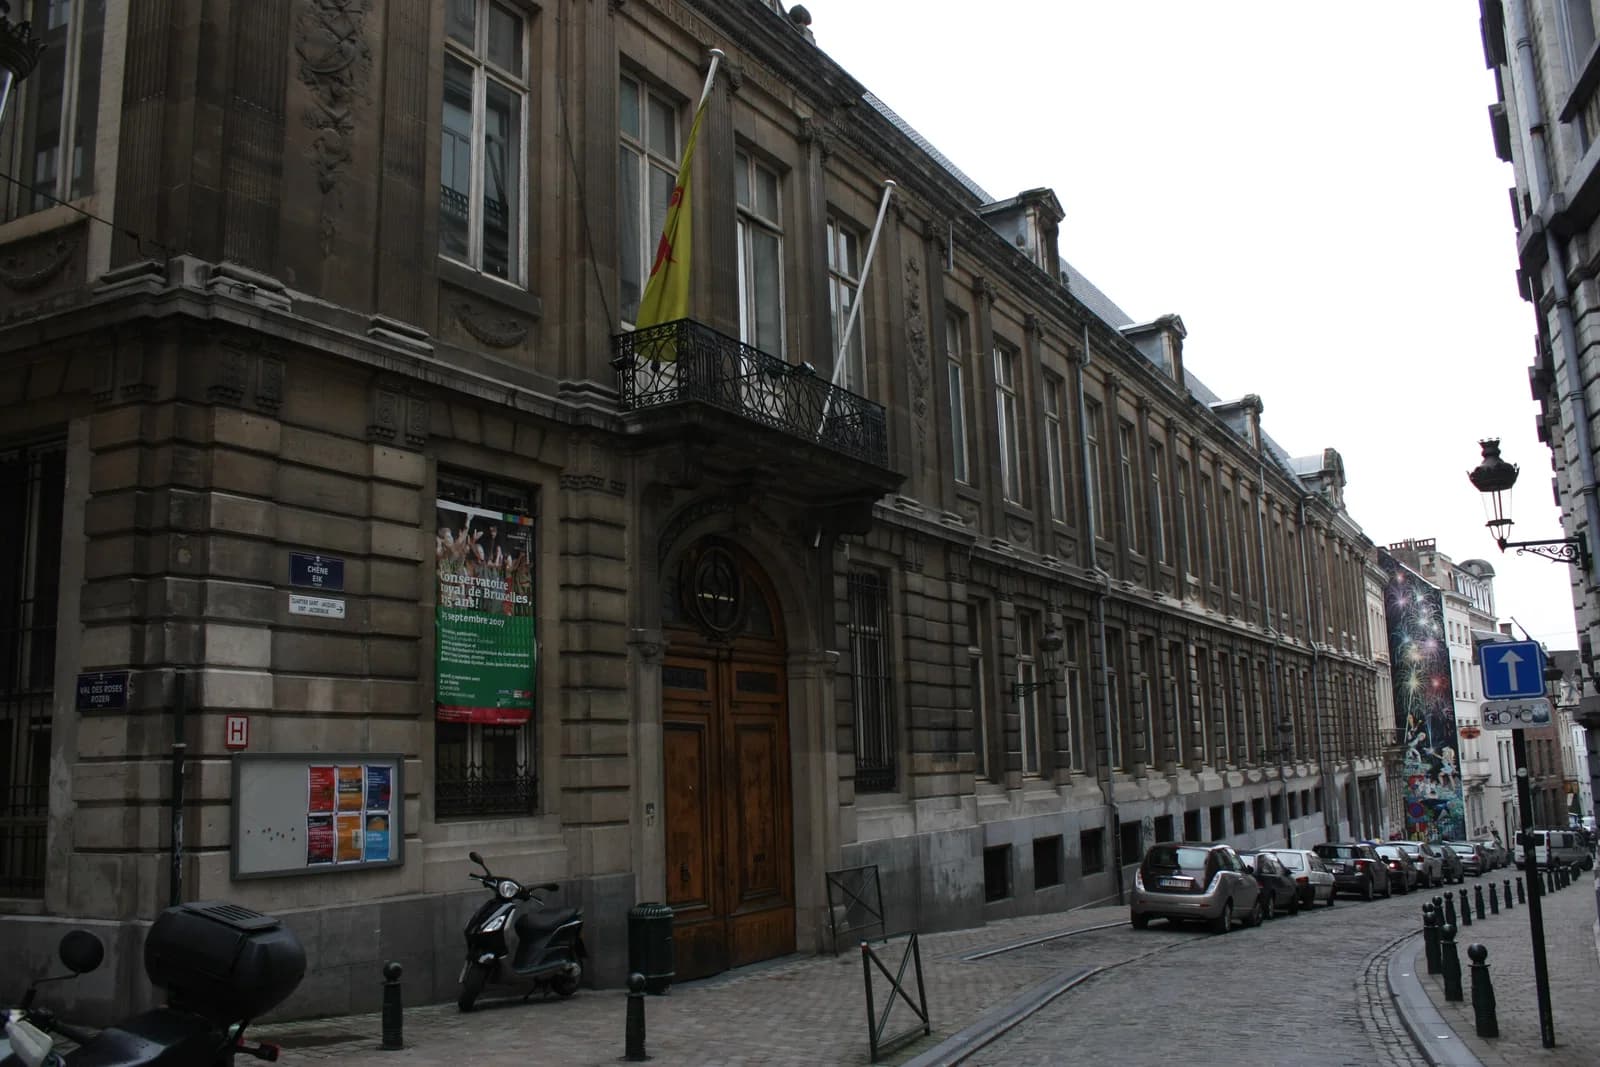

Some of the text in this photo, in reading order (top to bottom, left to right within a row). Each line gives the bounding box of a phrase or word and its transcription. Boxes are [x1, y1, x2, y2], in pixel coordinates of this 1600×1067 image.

[312, 575, 323, 583] EIK
[440, 571, 509, 590] Conservatoire
[440, 583, 532, 606] royal de Bruxelles,
[455, 597, 479, 609] ans!
[448, 613, 488, 625] septembre
[489, 619, 505, 628] 2007
[80, 684, 123, 695] VAL DES ROSES
[231, 721, 243, 741] H
